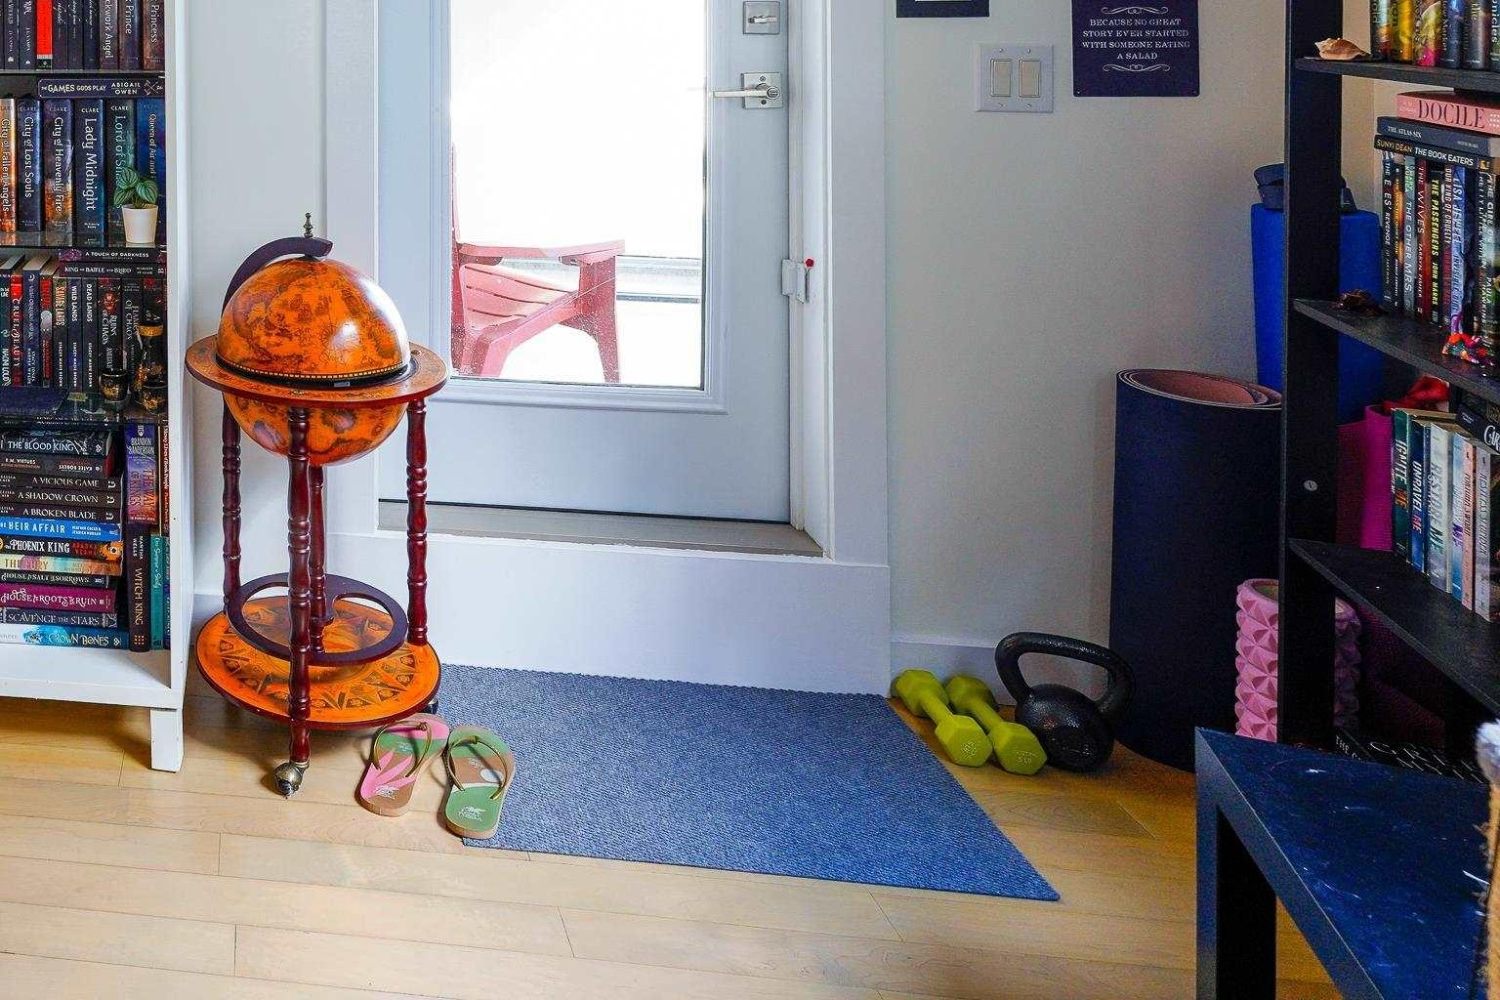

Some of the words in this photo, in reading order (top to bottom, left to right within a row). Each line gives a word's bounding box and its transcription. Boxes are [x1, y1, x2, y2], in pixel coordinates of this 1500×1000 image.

[125, 4, 135, 34] Prince
[150, 4, 160, 43] Princess
[1149, 18, 1181, 26] GREAT
[1144, 29, 1189, 37] STARTED
[103, 33, 113, 59] Angel
[1082, 41, 1107, 49] WITH
[1117, 52, 1124, 60] A
[1125, 52, 1158, 60] SALAD
[48, 84, 75, 93] GAMES
[1418, 100, 1485, 129] DOCILE
[1, 119, 11, 138] City
[22, 116, 34, 137] City
[53, 116, 64, 137] City
[82, 118, 97, 149] Lady
[115, 115, 126, 141] Lord
[149, 113, 157, 137] Queen
[116, 145, 126, 158] of
[1377, 140, 1395, 149] SUNYI
[1395, 144, 1412, 153] DEAN
[1414, 147, 1427, 156] THE
[1427, 149, 1447, 160] BOOK
[1448, 154, 1474, 166] EATERS
[2, 151, 11, 179] Fallen
[24, 149, 34, 169] Lost
[54, 149, 64, 191] Heavenly
[24, 172, 34, 198] Souls
[82, 153, 98, 211] Midnight
[1452, 178, 1462, 201] LISA
[1, 180, 11, 212] Angels
[55, 194, 64, 212] Fire
[1417, 190, 1425, 234] WIVES
[8, 441, 22, 449] THE
[24, 441, 52, 450] BLOOD
[1395, 439, 1407, 485] IGNITE
[39, 478, 73, 486] VICIOUS
[1412, 460, 1422, 512] UNRAVEL
[25, 492, 63, 501] SHADOW
[64, 495, 99, 503] CROWN
[30, 509, 67, 517] BROKEN
[68, 511, 97, 519] BLADE
[1412, 514, 1422, 534] ME
[9, 522, 30, 531] HEIR
[32, 523, 66, 533] AFFAIR
[10, 540, 45, 552] PHOENIX
[47, 541, 70, 553] KING
[5, 559, 21, 568] THE
[25, 560, 49, 569] FURY
[135, 568, 143, 600] WITCH
[39, 596, 69, 606] ROOTS
[75, 598, 97, 608] RUIN
[8, 613, 56, 623] SCAVENGE
[70, 616, 100, 625] STARS
[135, 603, 143, 626] KING
[79, 635, 109, 646] BONES
